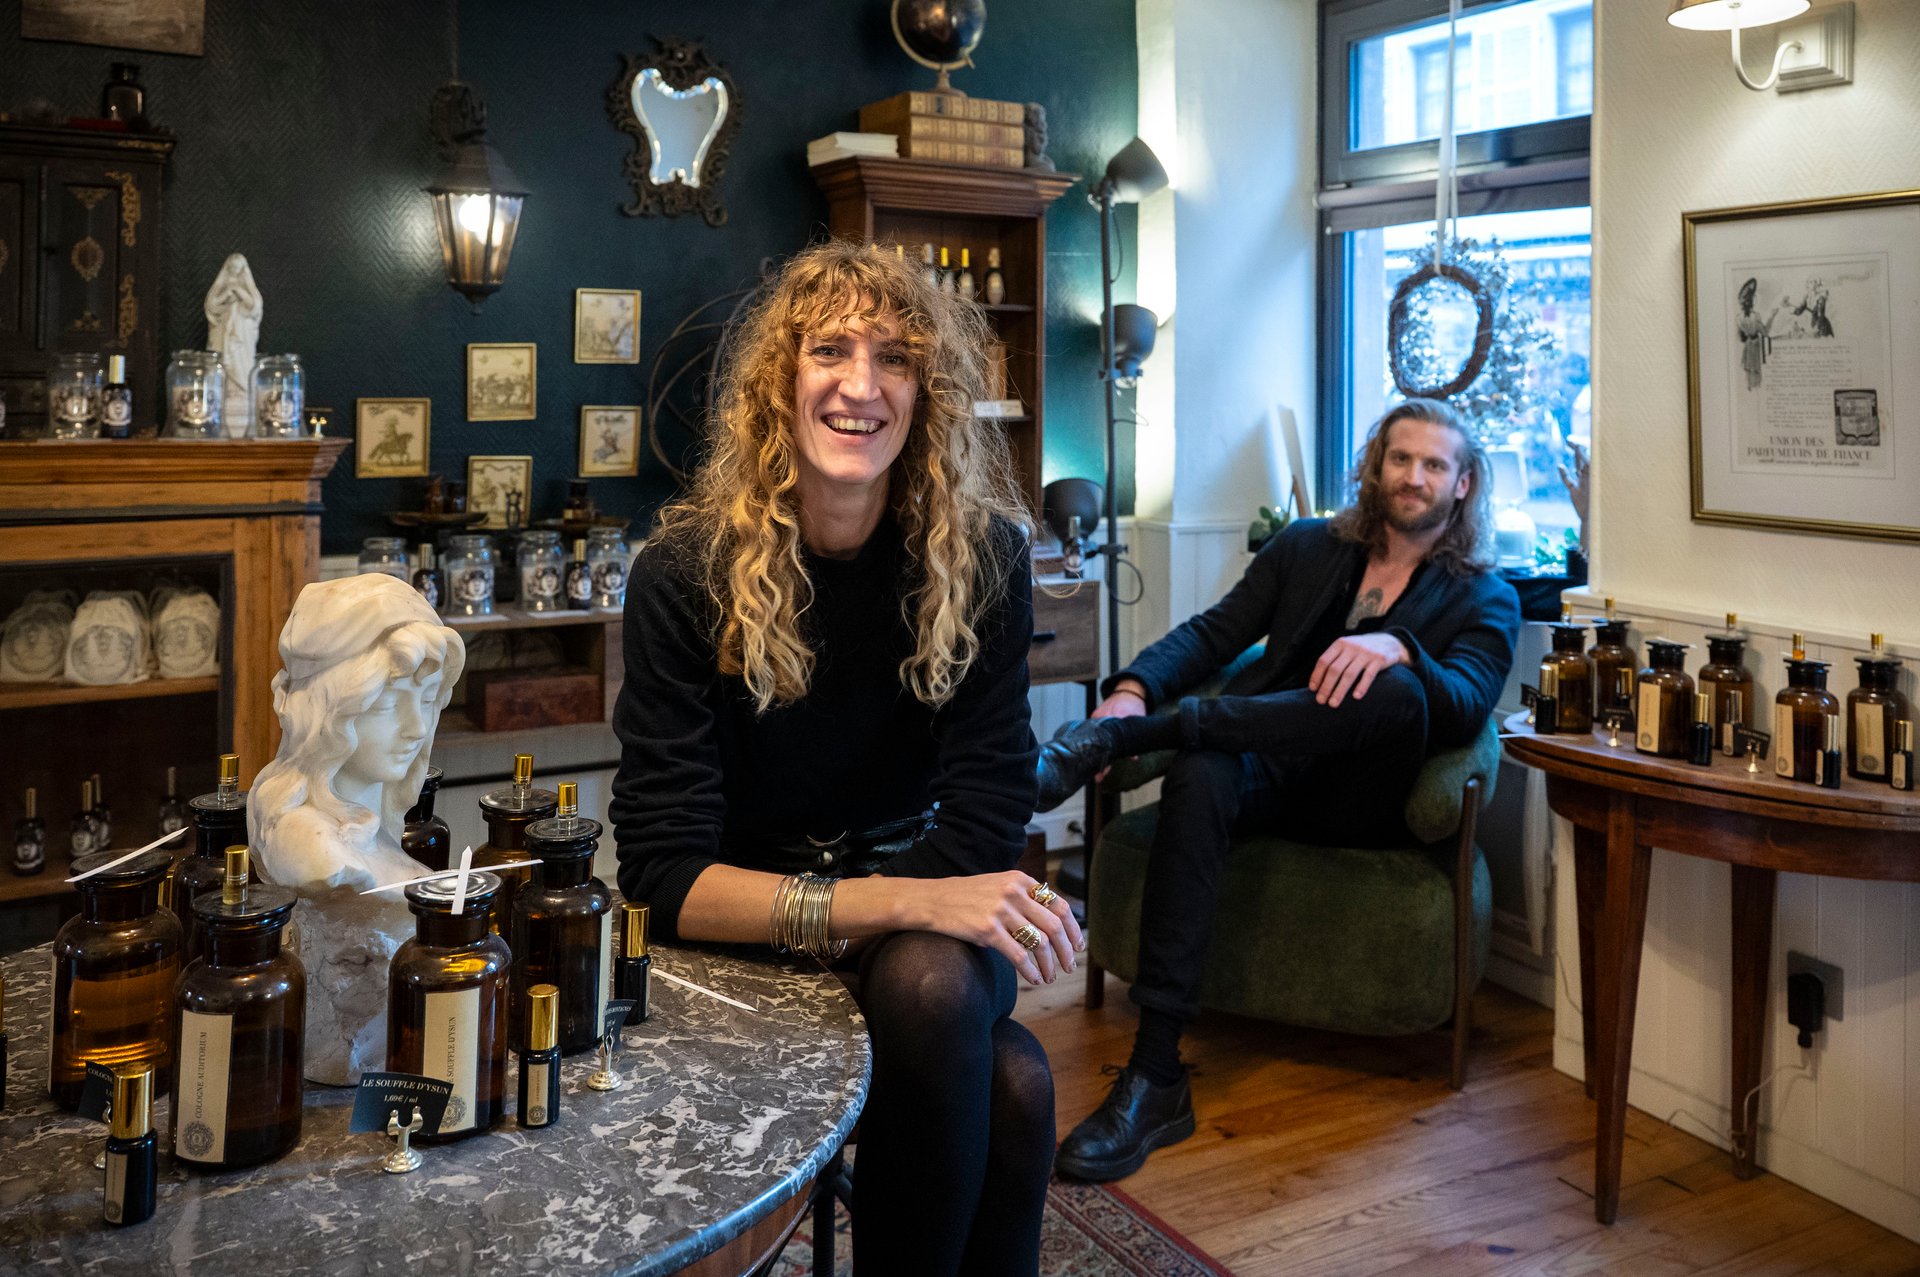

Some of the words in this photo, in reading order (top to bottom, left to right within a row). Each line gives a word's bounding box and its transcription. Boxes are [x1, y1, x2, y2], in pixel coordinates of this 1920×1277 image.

[1769, 436, 1801, 446] UNION
[1805, 436, 1824, 446] DES
[1747, 447, 1812, 459] PARFUMEURS
[1816, 448, 1828, 459] DE
[1834, 449, 1872, 461] FRANCE
[198, 1031, 207, 1080] AUDITORIUM
[446, 1044, 455, 1077] SOUFFLE
[87, 1067, 113, 1083] COLOGN
[362, 1079, 374, 1088] LE
[375, 1079, 415, 1089] SOUFFLE
[417, 1082, 449, 1095] D'YSUN
[194, 1081, 204, 1119] COLOGNE
